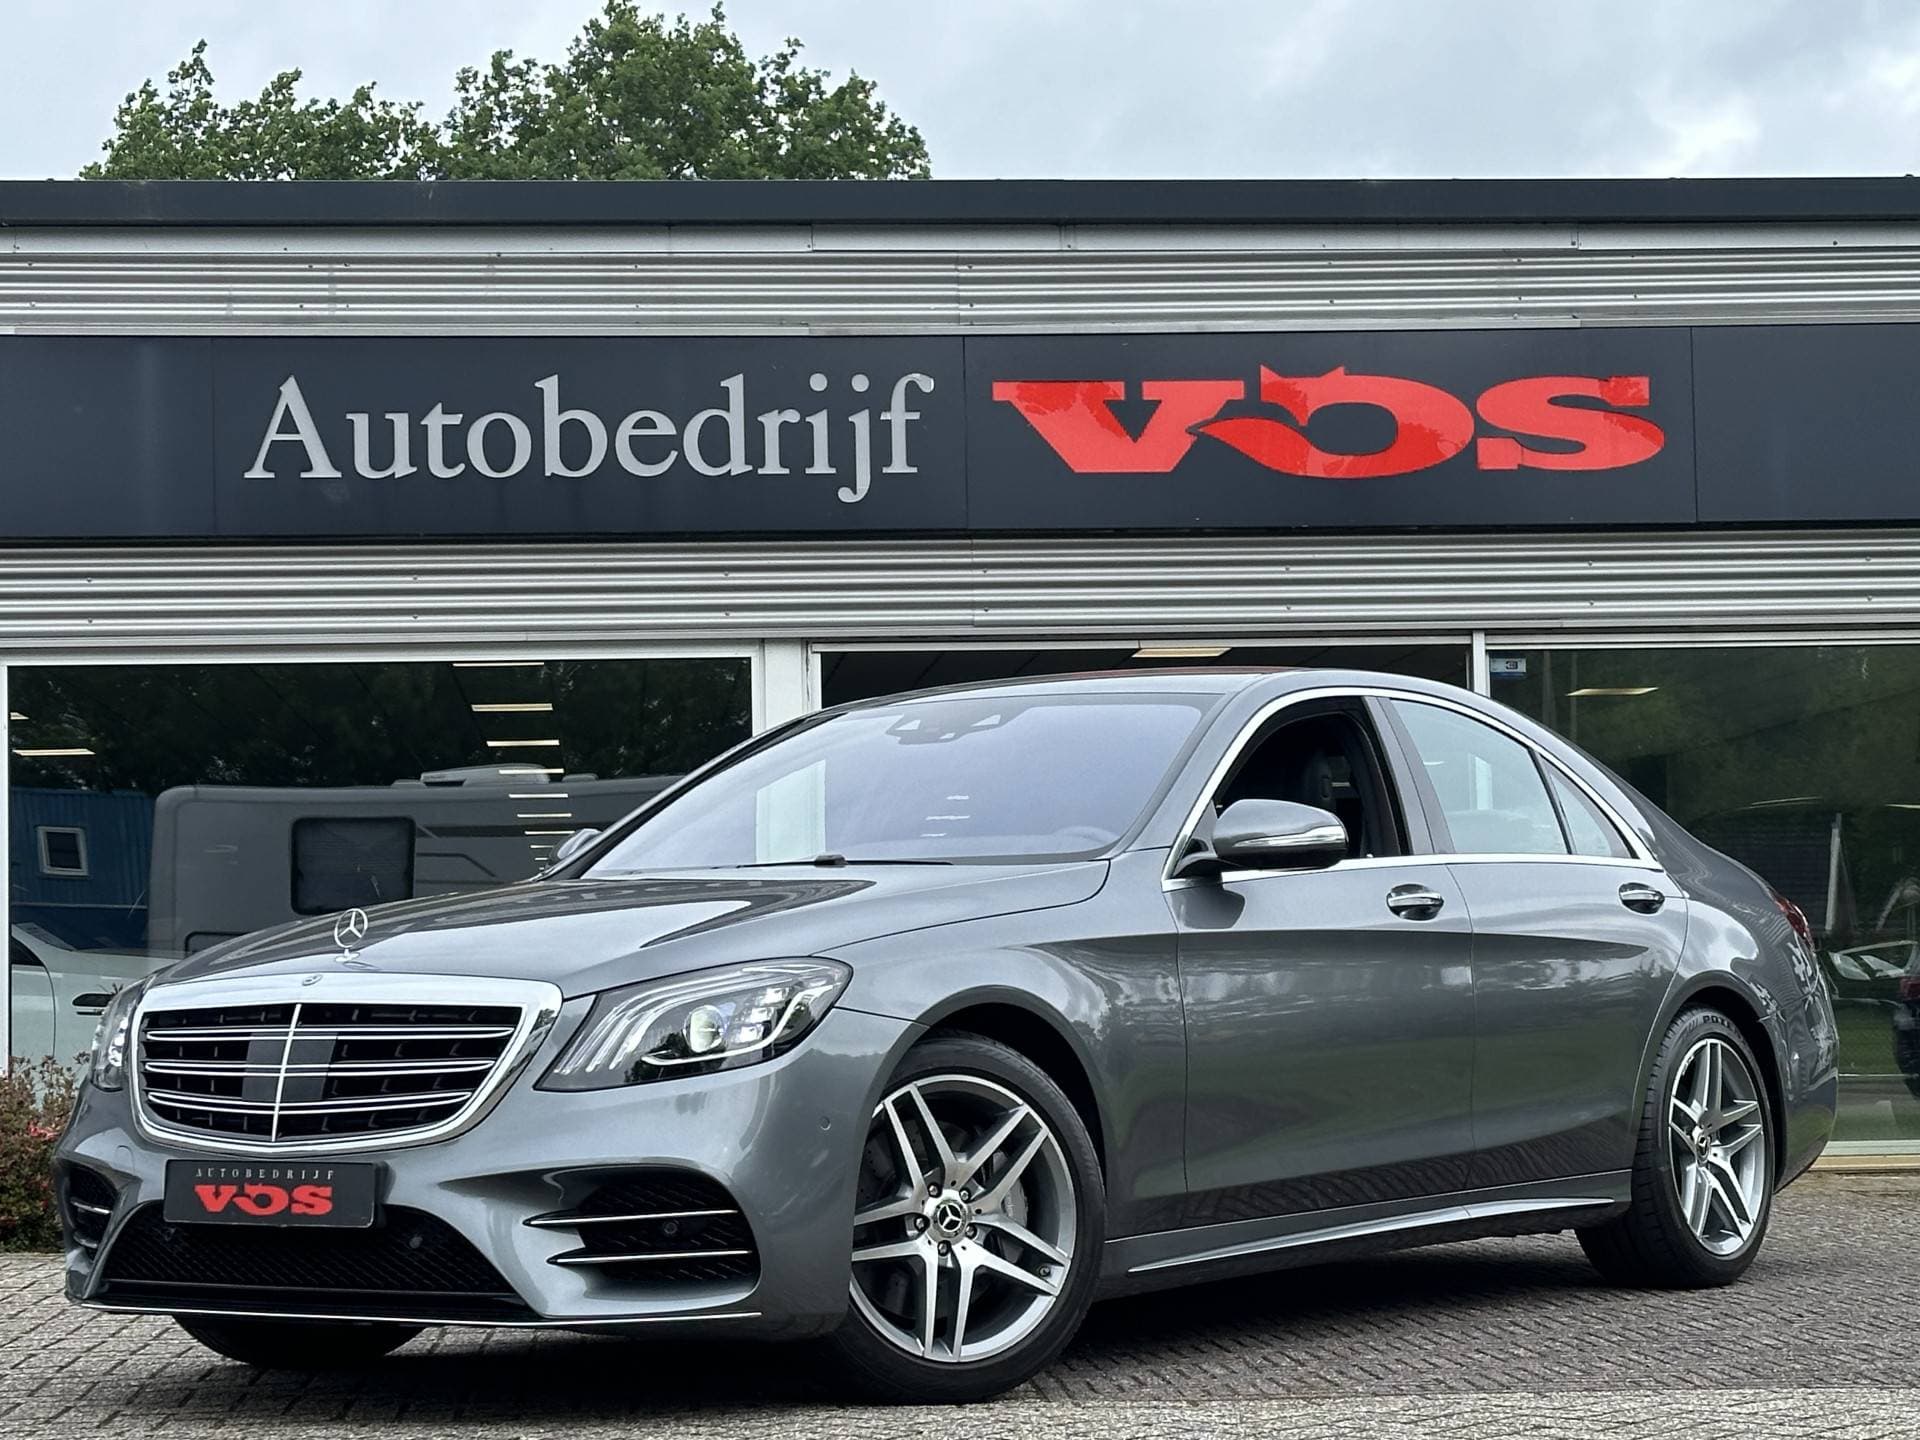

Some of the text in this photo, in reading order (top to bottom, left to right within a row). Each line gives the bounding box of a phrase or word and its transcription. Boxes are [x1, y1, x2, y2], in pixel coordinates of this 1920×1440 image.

[244, 364, 1666, 503] Autobedrijf VOS
[196, 1168, 334, 1180] AUTOBEDRIJF
[194, 1183, 333, 1216] VOS
